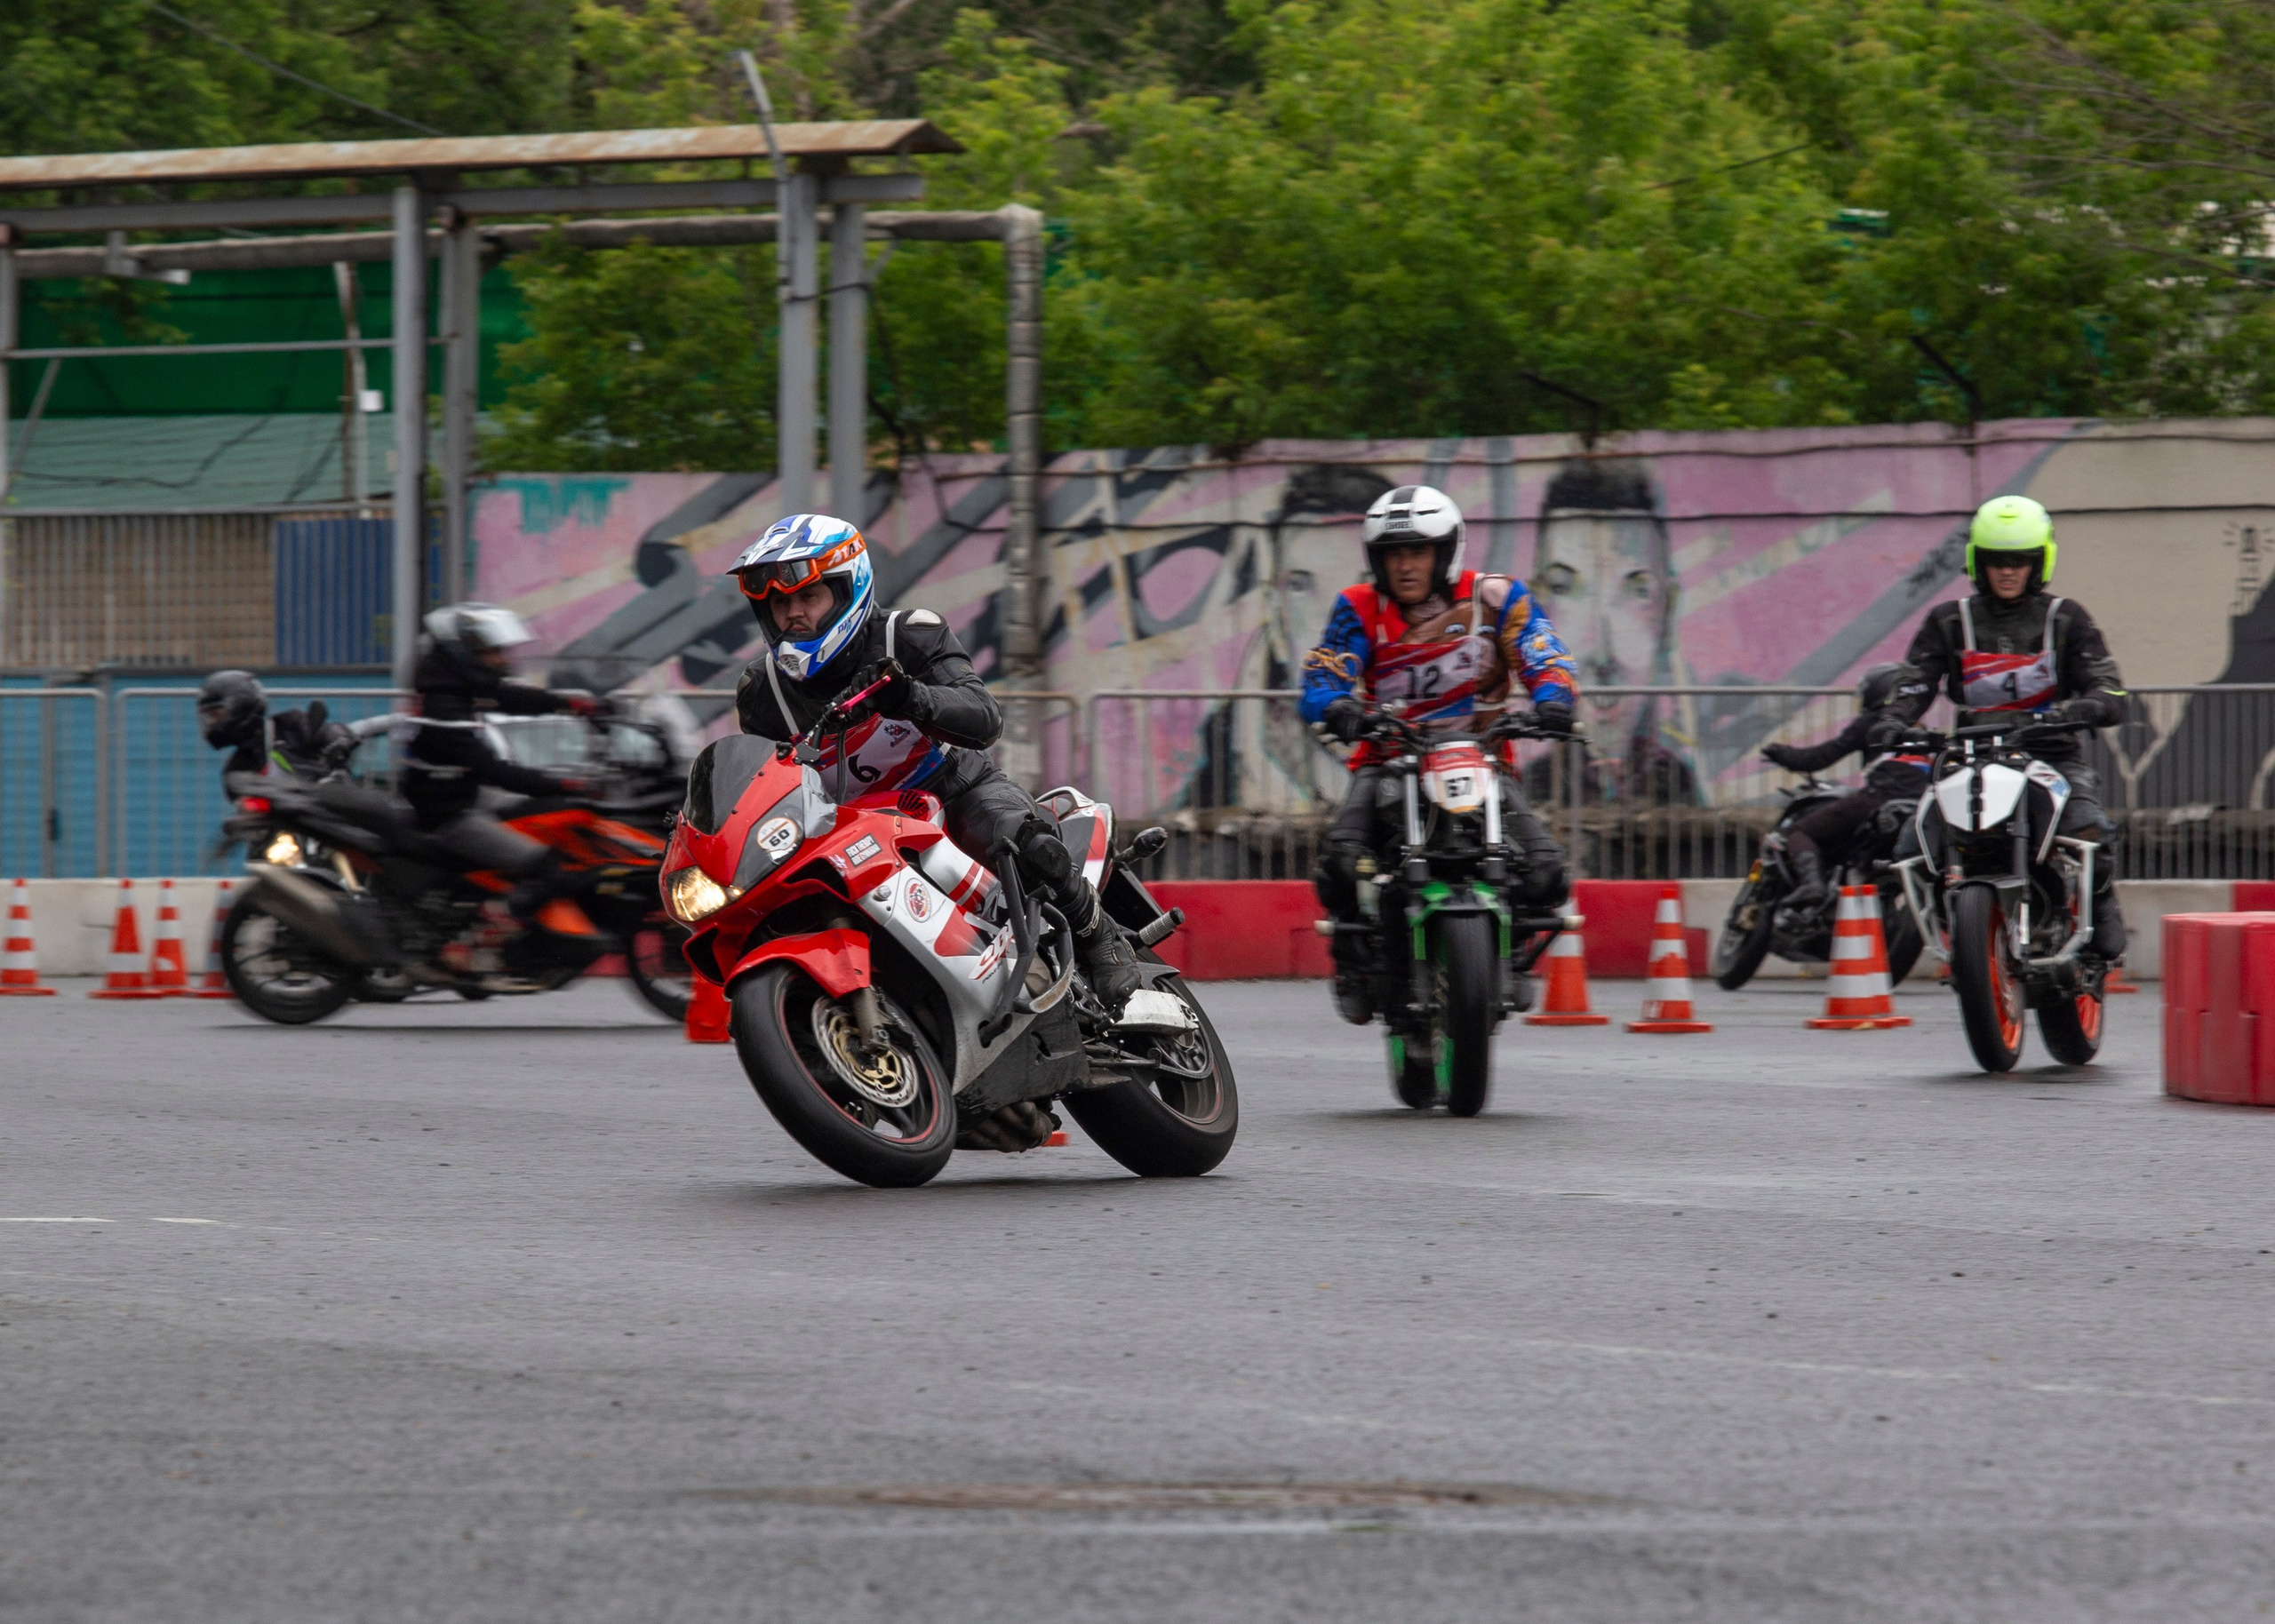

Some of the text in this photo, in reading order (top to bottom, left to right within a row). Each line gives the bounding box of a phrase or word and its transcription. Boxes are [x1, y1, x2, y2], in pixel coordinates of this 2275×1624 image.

[1405, 665, 1441, 699] 12
[2002, 672, 2017, 700] 4
[848, 753, 882, 783] 6
[769, 828, 790, 848] 60
